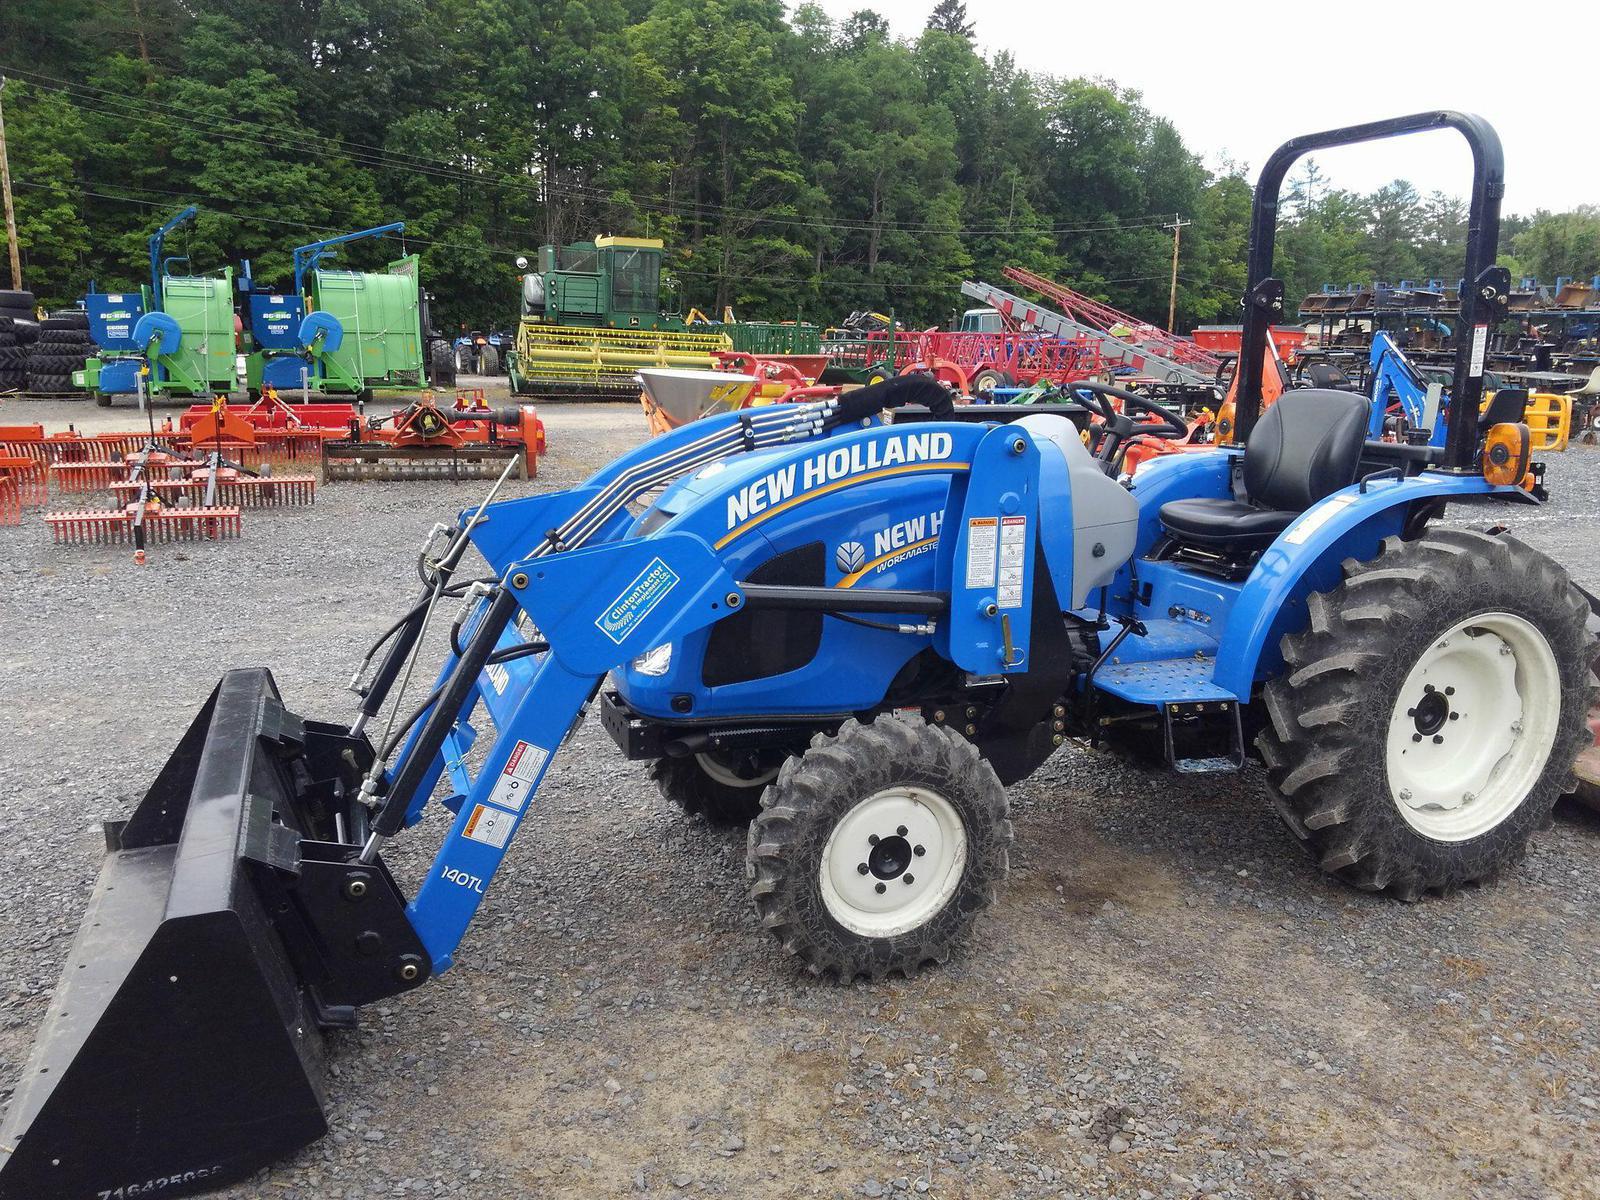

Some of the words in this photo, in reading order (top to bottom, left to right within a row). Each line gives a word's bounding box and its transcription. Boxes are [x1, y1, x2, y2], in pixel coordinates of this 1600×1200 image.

[727, 464, 797, 530] NEW
[804, 432, 952, 490] HOLLAND
[874, 515, 926, 557] NEW
[634, 578, 661, 606] Implement
[508, 743, 525, 767] DANGER
[441, 865, 483, 894] 140TL
